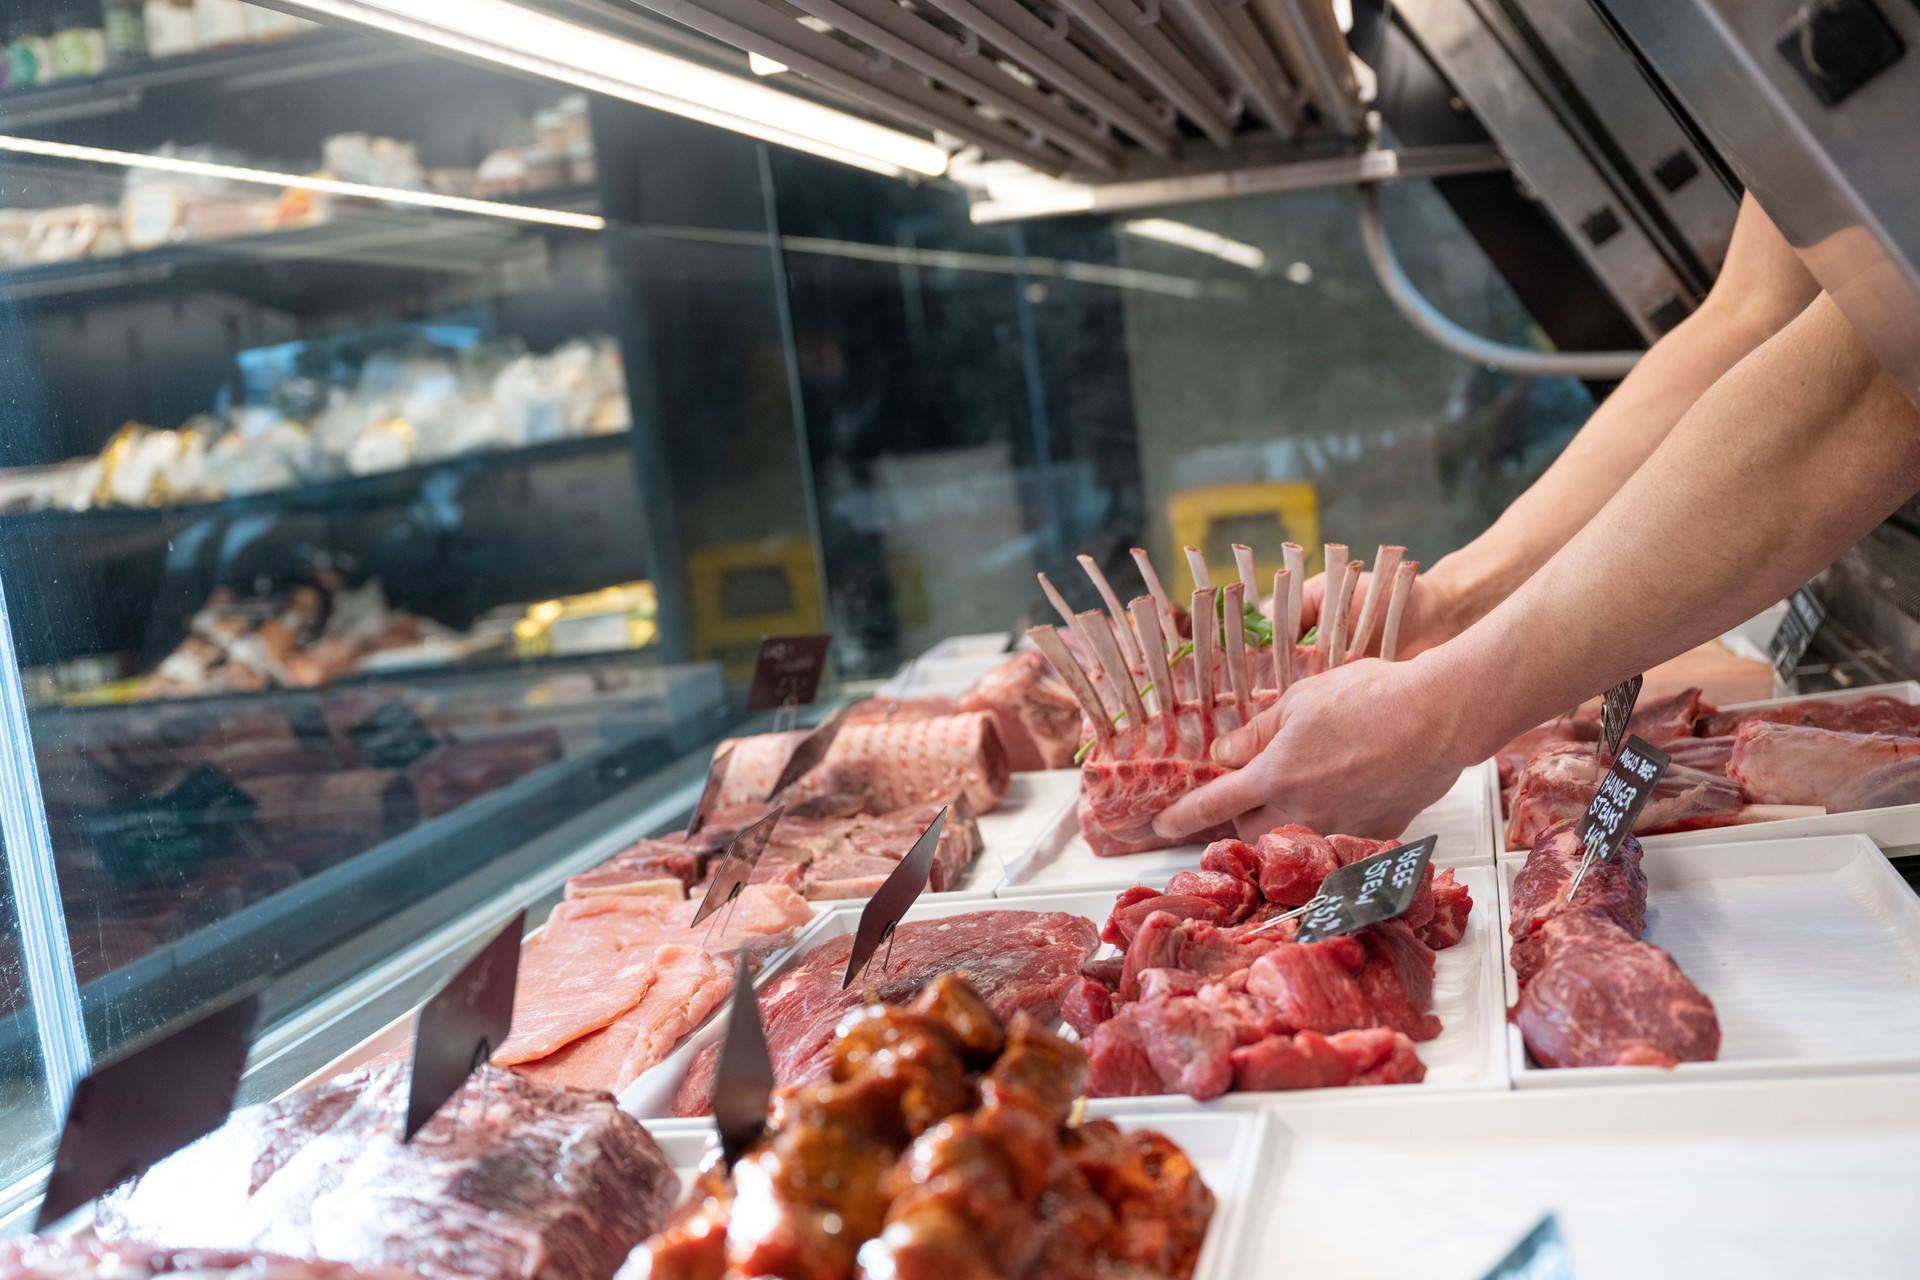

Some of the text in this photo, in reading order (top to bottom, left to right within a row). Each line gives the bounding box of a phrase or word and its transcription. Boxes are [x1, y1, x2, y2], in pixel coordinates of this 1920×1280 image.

[1619, 747, 1658, 782] ANGUS BEEF
[1600, 770, 1637, 811] HANGER
[1589, 795, 1623, 835] STEAKS
[1354, 859, 1392, 905] STEW
[1392, 845, 1425, 889] BEEF
